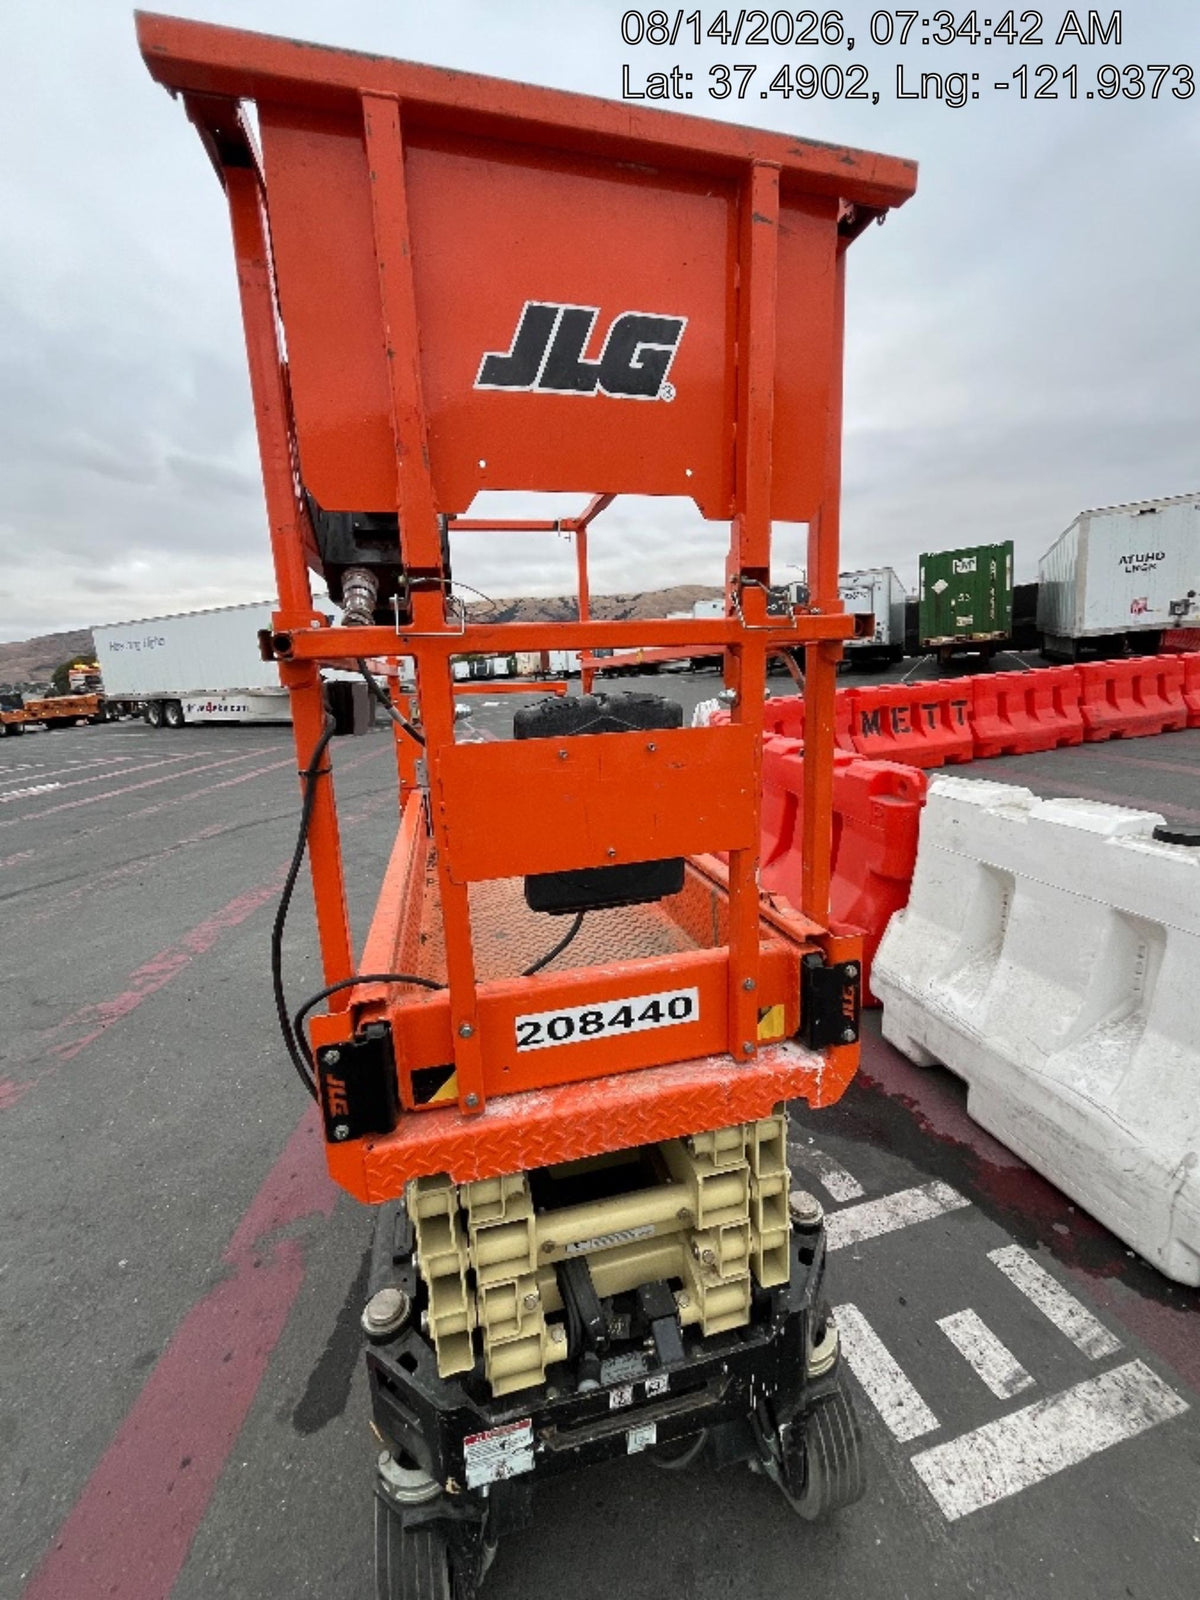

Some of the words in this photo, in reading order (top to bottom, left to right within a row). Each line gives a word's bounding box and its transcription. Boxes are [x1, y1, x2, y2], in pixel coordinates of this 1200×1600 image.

[473, 300, 688, 401] JLG
[516, 996, 693, 1047] 208440
[326, 1073, 349, 1118] JLG
